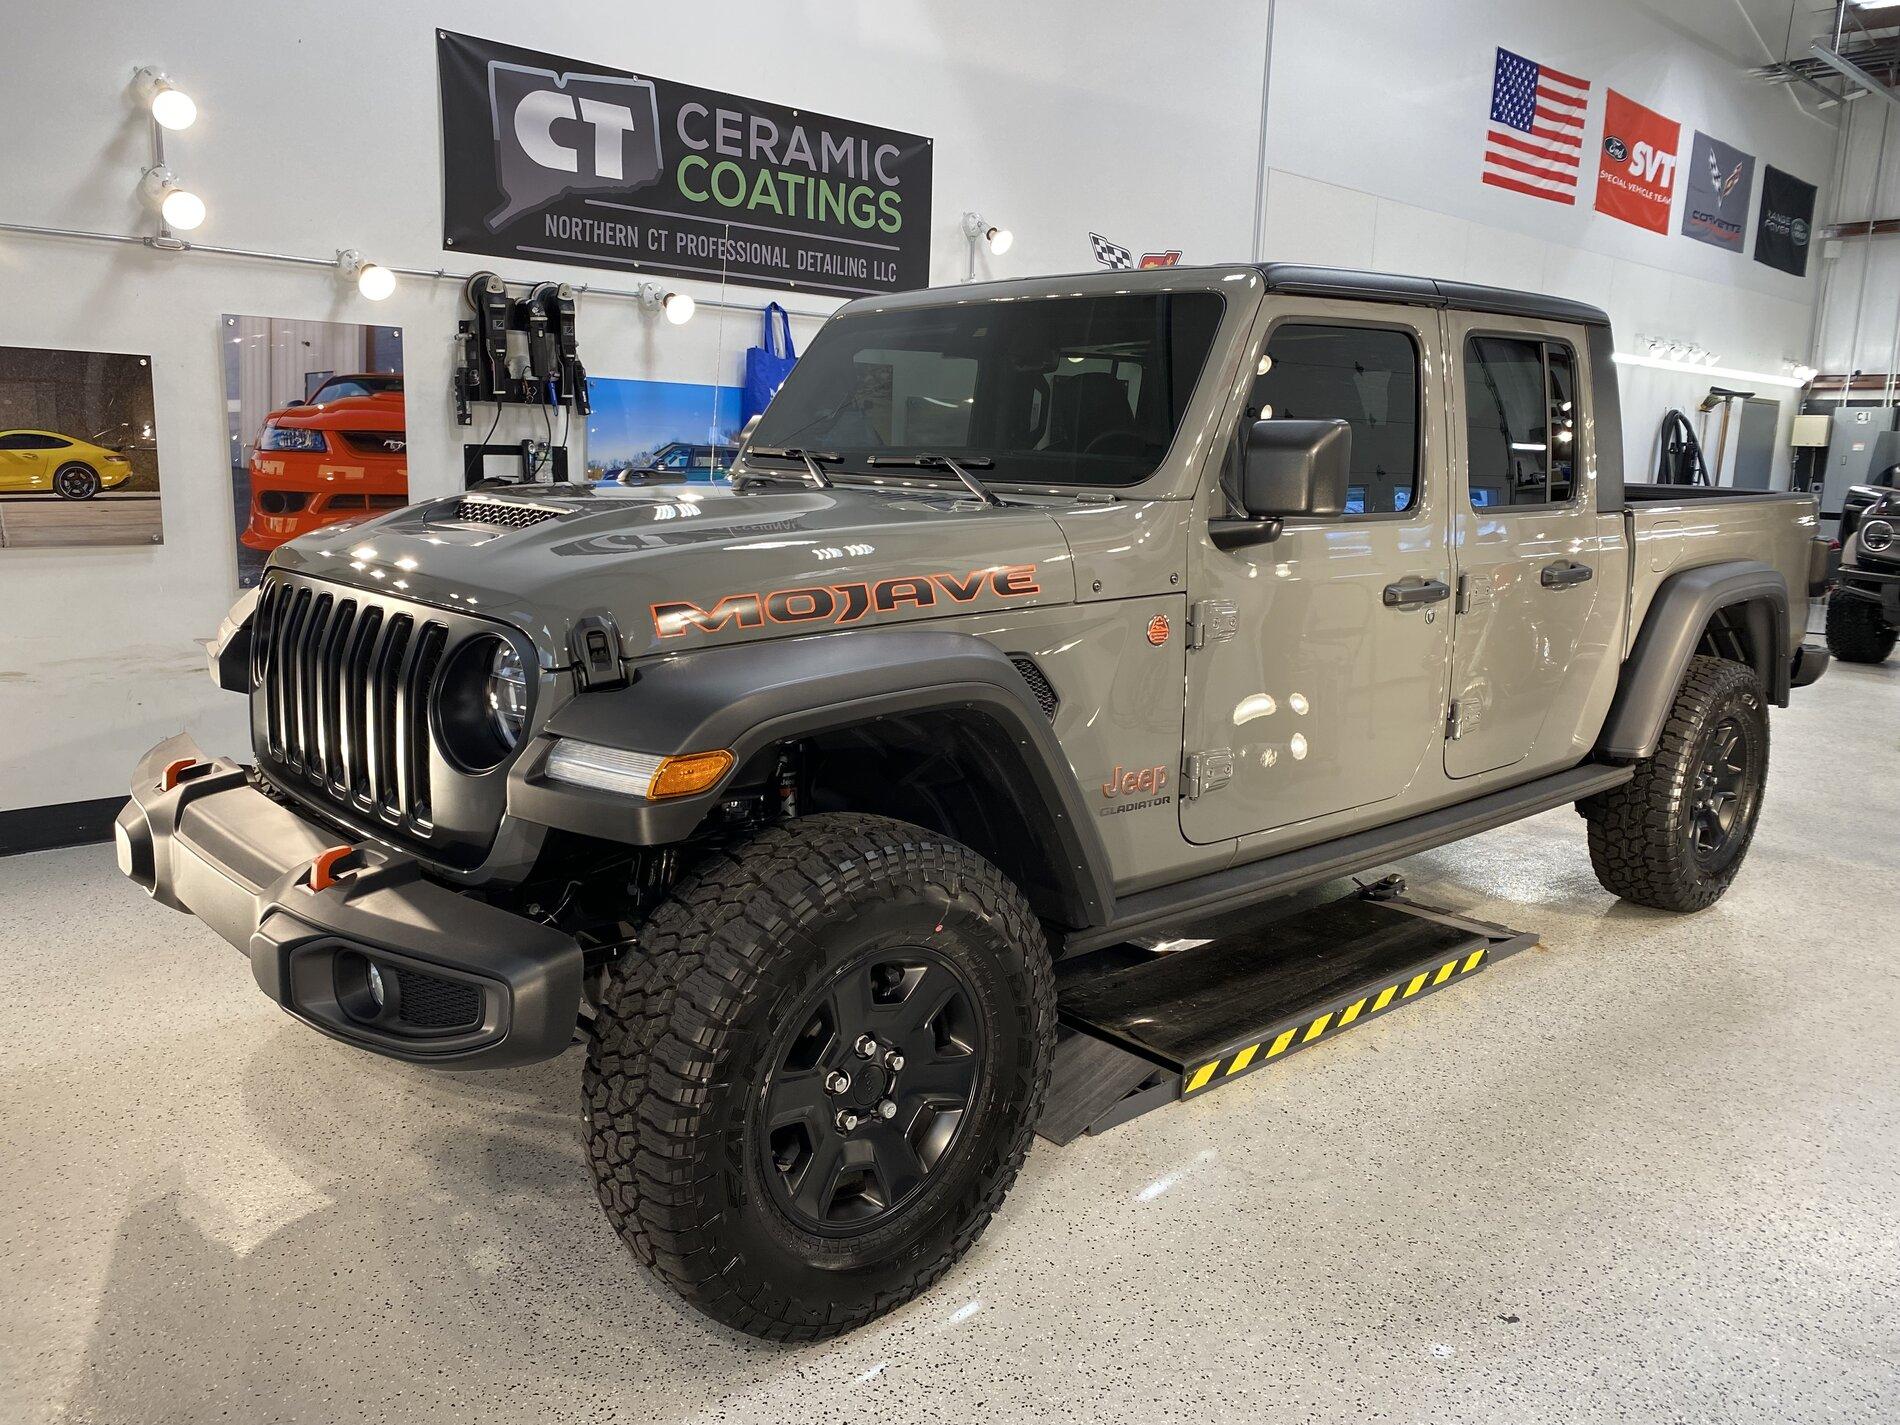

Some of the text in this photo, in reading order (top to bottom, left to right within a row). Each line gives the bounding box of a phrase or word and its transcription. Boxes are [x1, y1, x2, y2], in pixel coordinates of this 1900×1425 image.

[514, 90, 634, 180] CT
[677, 102, 901, 187] CERAMIC
[1628, 141, 1677, 188] SVT
[677, 155, 903, 234] COATINGS
[1600, 170, 1628, 189] SPECIAL
[1628, 182, 1655, 201] VEHICLE
[545, 213, 897, 283] NORTHERN CT PROFESSIONAL DETAILING LLC
[650, 564, 1040, 639] MOJAVE
[1100, 796, 1171, 817] GLADIATOR
[1102, 764, 1169, 799] Jeep
